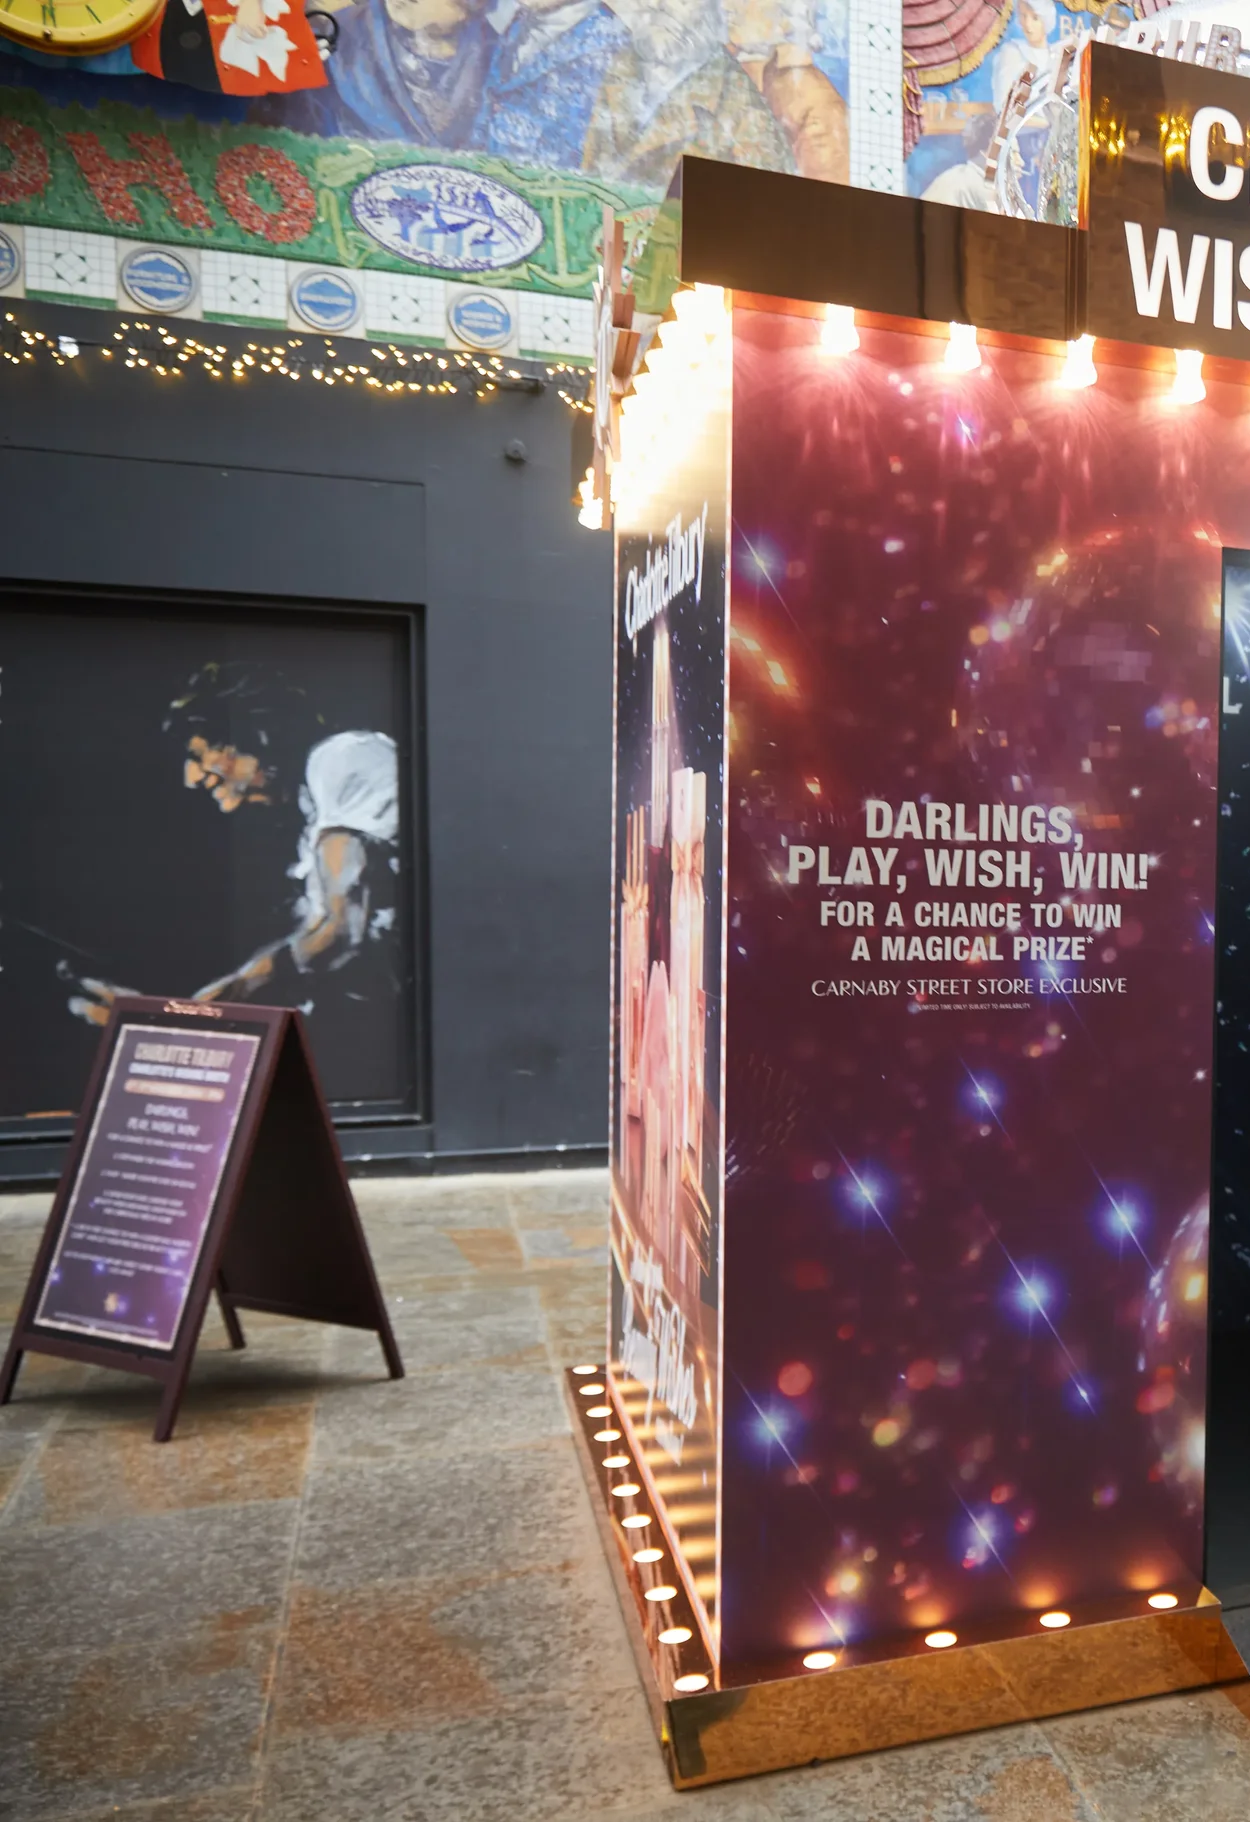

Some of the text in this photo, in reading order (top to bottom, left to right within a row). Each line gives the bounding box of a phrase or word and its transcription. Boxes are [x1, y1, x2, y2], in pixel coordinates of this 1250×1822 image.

[866, 800, 1084, 851] DARLINGS,
[787, 845, 1149, 895] PLAY, WISH, WIN!
[820, 901, 1121, 929] FOR A CHANCE TO WIN
[851, 936, 871, 961] A
[881, 936, 1003, 962] MAGICAL
[811, 977, 1127, 997] CARNABY STREET STORE EXCLUSIVE
